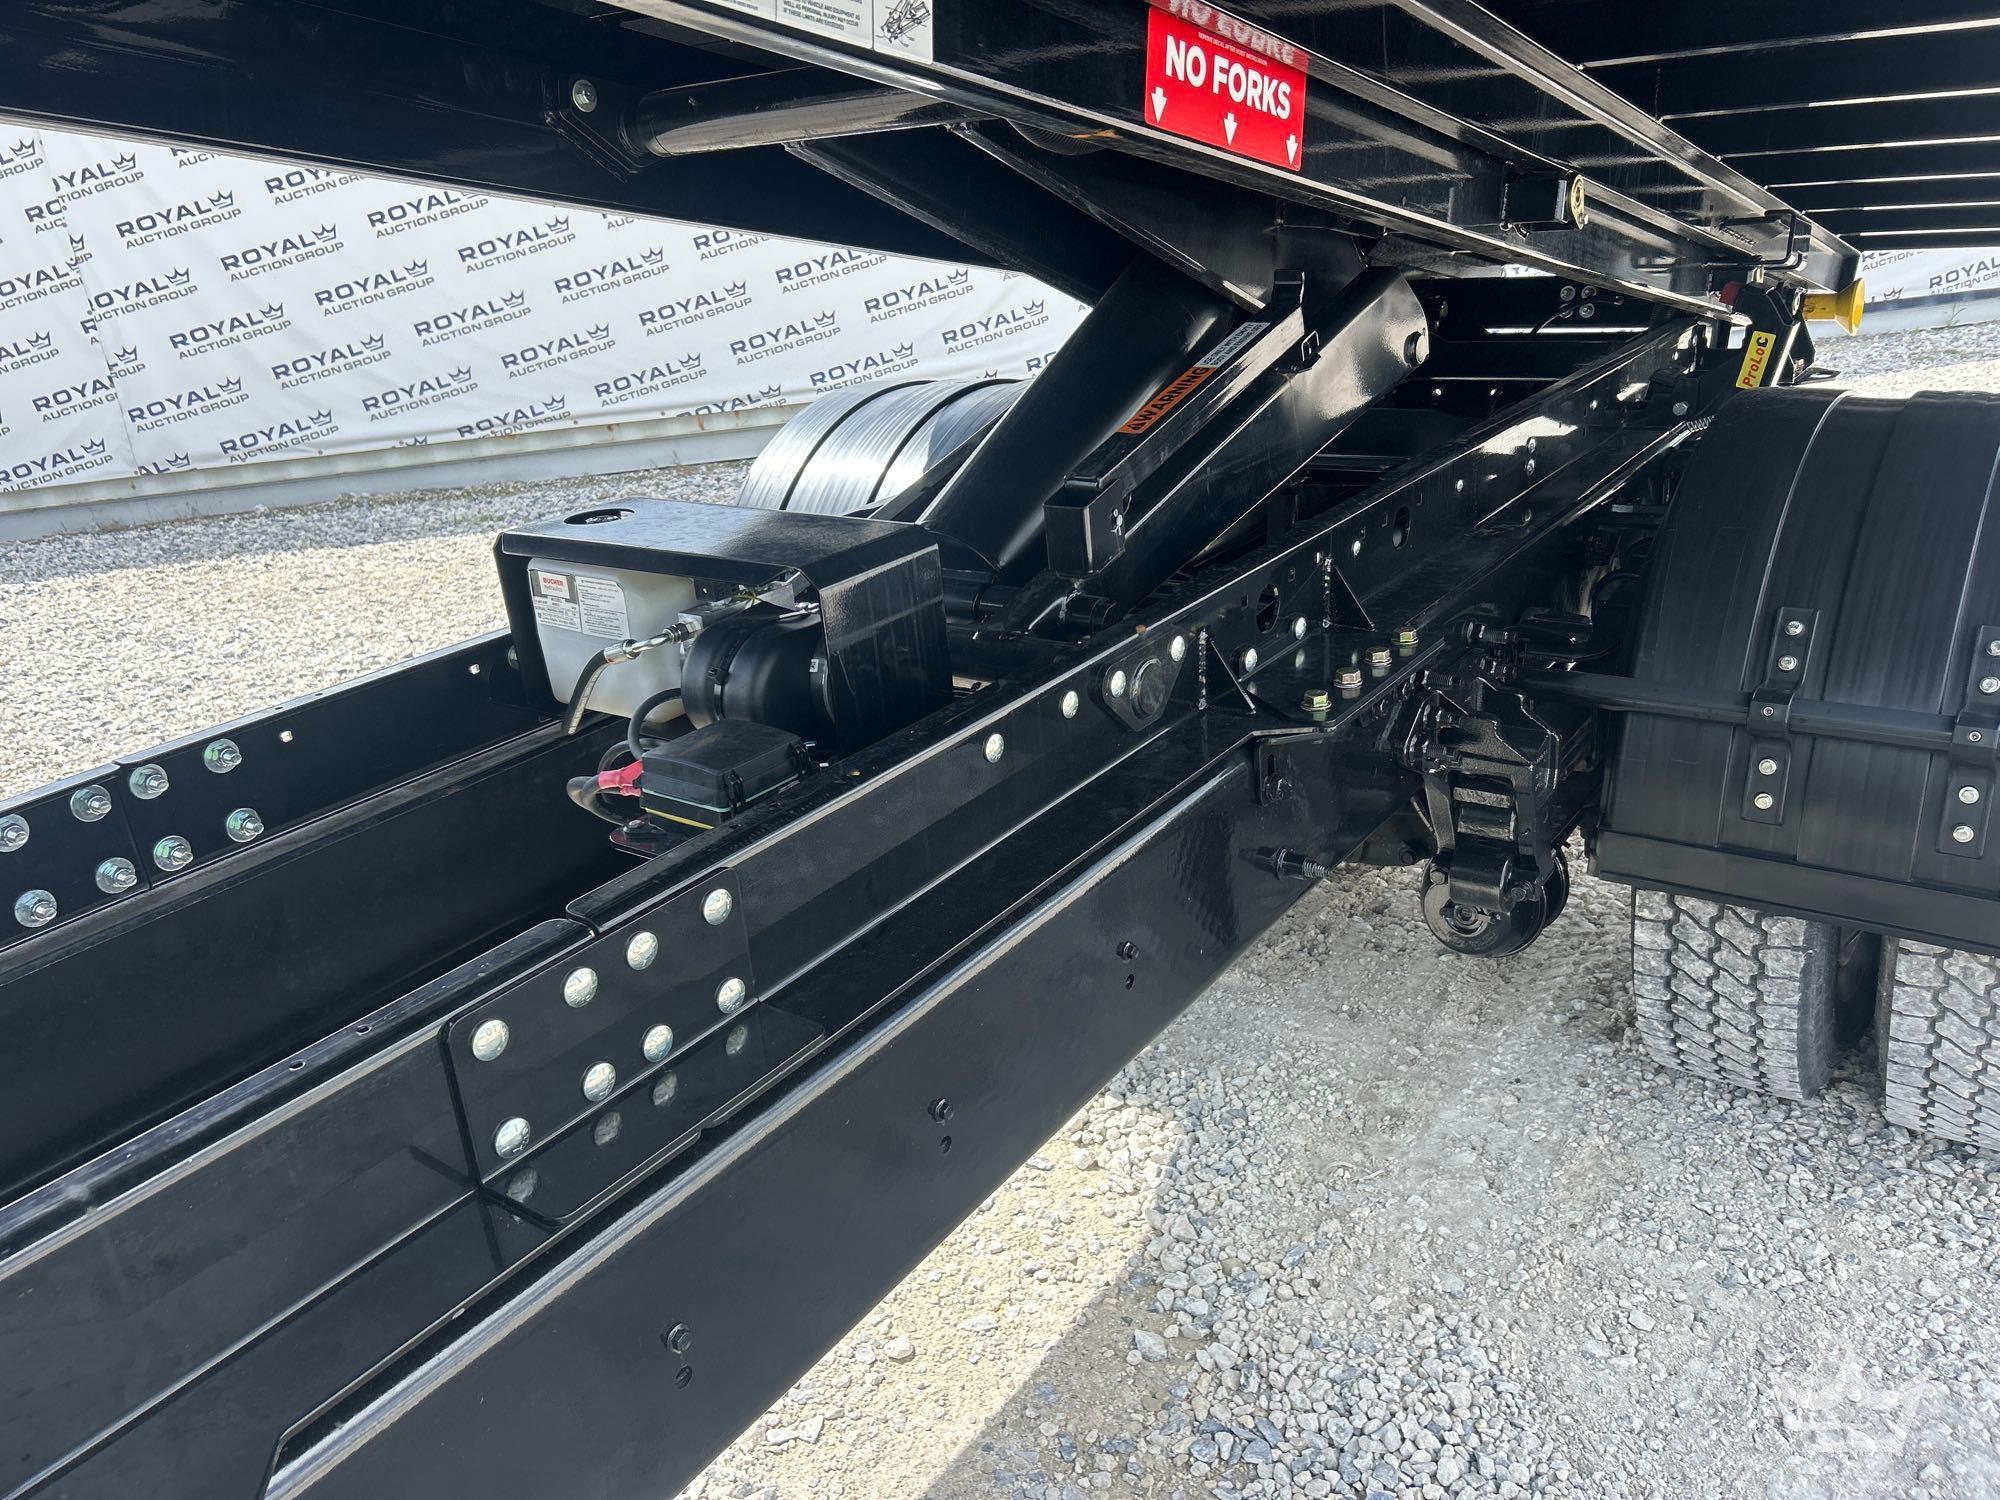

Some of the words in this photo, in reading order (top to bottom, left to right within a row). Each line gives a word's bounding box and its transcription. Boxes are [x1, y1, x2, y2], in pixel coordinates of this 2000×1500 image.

[1165, 34, 1206, 88] NO
[1212, 54, 1291, 120] FORKS
[52, 163, 115, 192] YAL
[58, 187, 92, 204] TION
[94, 171, 144, 193] GROUP
[274, 180, 337, 205] AUCTION
[116, 201, 212, 238] ROYAL
[367, 191, 462, 228] ROYAL
[376, 213, 438, 239] AUCTION
[440, 198, 489, 220] GROUP
[126, 224, 189, 249] AUCTION
[191, 208, 242, 229] GROUP
[457, 226, 550, 263] ROYAL
[220, 234, 316, 271] ROYAL
[230, 256, 294, 282] AUCTION
[295, 241, 344, 263] GROUP
[466, 248, 527, 274] AUCTION
[528, 233, 576, 255] GROUP
[699, 236, 759, 261] AUCTION
[775, 250, 862, 284] ROYAL
[1862, 250, 1914, 271] AUCTION
[0, 265, 70, 297] OYAL
[314, 269, 407, 306] ROYAL
[554, 257, 644, 293] ROYAL
[561, 278, 621, 304] AUCTION
[622, 264, 670, 285] GROUP
[782, 269, 840, 295] AUCTION
[841, 255, 887, 275] GROUP
[1929, 257, 2000, 289] ROYAL
[0, 288, 48, 311] UCTION
[49, 277, 83, 294] GRO
[88, 277, 169, 312] OYAL
[94, 300, 147, 323] UCTION
[150, 285, 198, 307] GROUP
[323, 292, 385, 317] AUCTION
[386, 276, 435, 298] GROUP
[638, 290, 727, 326] ROYAL
[864, 278, 949, 314] ROYAL
[870, 299, 927, 324] AUCTION
[928, 284, 974, 304] GROUP
[169, 312, 264, 349] ROYAL
[413, 300, 505, 337] ROYAL
[422, 322, 483, 347] AUCTION
[484, 307, 532, 328] GROUP
[646, 312, 705, 337] AUCTION
[706, 297, 752, 318] GROUP
[942, 309, 1025, 345] ROYAL
[947, 330, 1003, 355] AUCTION
[1004, 315, 1049, 336] GROUP
[179, 335, 241, 360] AUCTION
[243, 320, 292, 340] GROUP
[501, 333, 589, 369] ROYAL
[730, 321, 816, 356] ROYAL
[736, 342, 794, 366] AUCTION
[795, 327, 841, 347] GROUP
[11, 349, 59, 370] GROUP
[271, 343, 364, 380] ROYAL
[281, 366, 342, 390] AUCTION
[344, 350, 392, 371] GROUP
[508, 354, 569, 380] AUCTION
[569, 340, 616, 361] GROUP
[809, 352, 894, 387] ROYAL
[815, 372, 873, 395] AUCTION
[874, 358, 919, 378] GROUP
[362, 376, 452, 412] ROYAL
[594, 362, 682, 398] ROYAL
[601, 384, 660, 408] AUCTION
[661, 369, 708, 389] GROUP
[1138, 367, 1210, 420] WARNING
[42, 397, 103, 422] AUCTION
[128, 386, 221, 423] ROYAL
[136, 408, 199, 433] AUCTION
[200, 393, 250, 414] GROUP
[370, 398, 430, 422] AUCTION
[431, 382, 479, 404] GROUP
[219, 419, 312, 455] ROYAL
[456, 405, 545, 438] ROYAL
[230, 440, 292, 463] AUCTION
[292, 425, 339, 446] GROUP
[3, 471, 63, 494] AUCTION
[65, 455, 113, 475] GROUP
